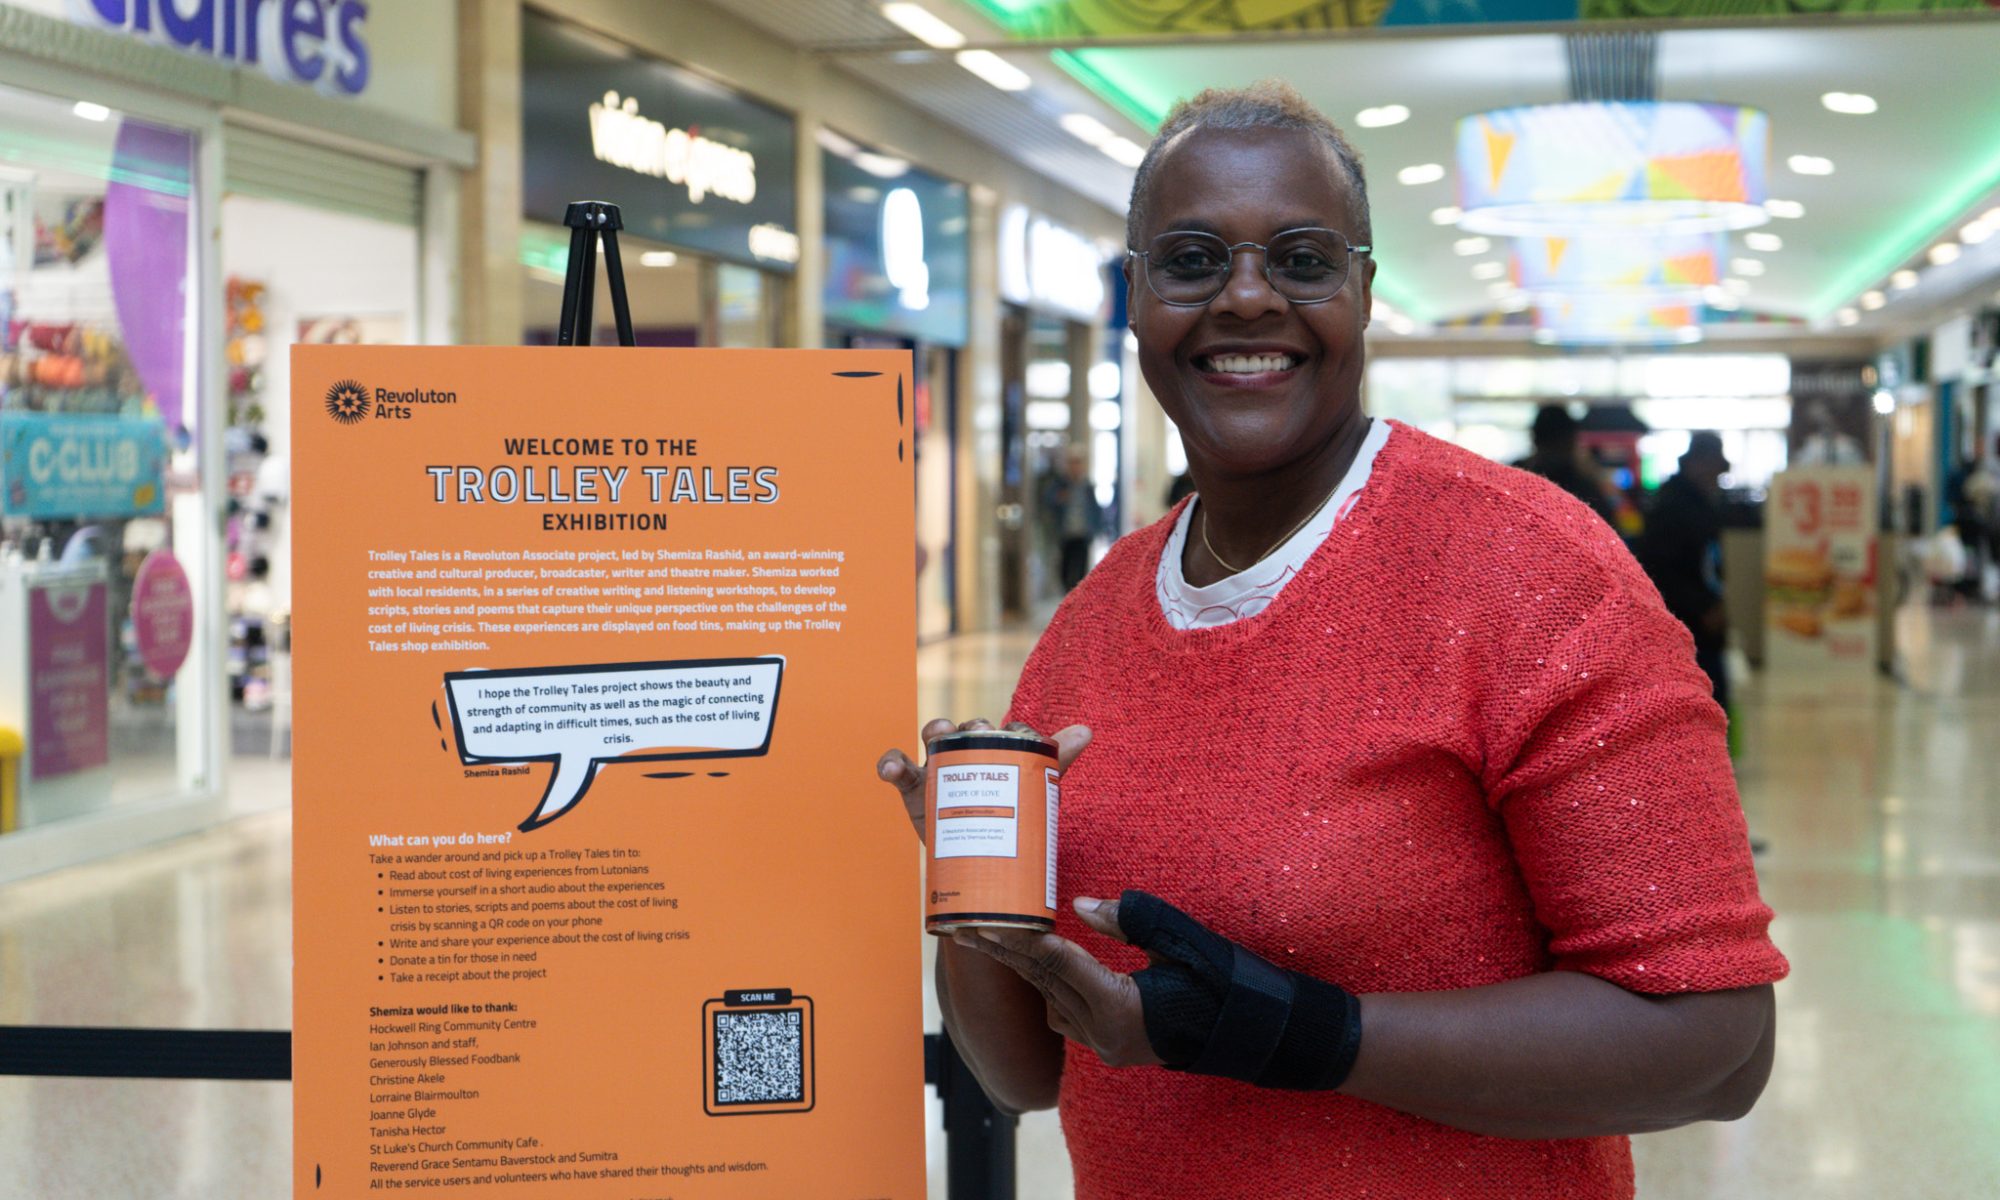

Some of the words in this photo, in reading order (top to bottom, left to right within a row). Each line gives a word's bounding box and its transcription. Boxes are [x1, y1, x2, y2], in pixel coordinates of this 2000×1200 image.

[375, 388, 457, 404] Revoluton
[375, 405, 412, 419] Arts
[504, 438, 614, 456] WELCOME
[621, 438, 649, 456] TO
[655, 438, 697, 456] THE
[426, 466, 629, 504] TROLLEY
[642, 466, 780, 504] TALES
[543, 513, 667, 531] EXHIBITION
[368, 550, 408, 563] Trolley
[409, 550, 439, 561] Tales
[441, 550, 452, 561] is
[454, 552, 461, 561] a
[463, 550, 520, 561] Revoluton
[522, 549, 576, 561] Associate
[578, 550, 619, 563] project,
[622, 550, 639, 560] led
[641, 550, 655, 562] by
[657, 549, 703, 560] Shemiza
[705, 549, 745, 561] Rashid,
[747, 551, 761, 560] an
[763, 549, 845, 563] award-winning
[368, 568, 414, 579] creative
[415, 568, 437, 579] and
[439, 568, 483, 579] cultural
[485, 568, 538, 580] producer,
[540, 568, 609, 579] broadcaster,
[611, 568, 645, 578] writer
[647, 567, 668, 578] and
[670, 568, 710, 578] theatre
[712, 567, 749, 577] maker.
[752, 566, 798, 577] Shemiza
[799, 566, 840, 577] worked
[368, 640, 399, 652] Tales
[401, 640, 429, 653] shop
[431, 640, 490, 651] exhibition.
[478, 689, 482, 699] I
[484, 689, 511, 700] hope
[513, 687, 531, 697] the
[533, 685, 569, 697] Trolley
[571, 684, 599, 694] Tales
[601, 682, 638, 695] project
[640, 681, 673, 691] shows
[675, 679, 693, 689] the
[695, 678, 730, 689] beauty
[732, 675, 752, 686] and
[467, 705, 512, 718] strength
[515, 704, 526, 714] of
[528, 702, 587, 714] community
[589, 702, 602, 711] as
[603, 699, 626, 710] well
[628, 700, 640, 709] as
[642, 698, 660, 708] the
[662, 696, 693, 709] magic
[695, 694, 706, 705] of
[708, 692, 764, 705] connecting
[473, 723, 493, 734] and
[495, 721, 542, 734] adapting
[544, 720, 554, 730] in
[556, 718, 598, 730] difficult
[599, 717, 632, 727] times,
[634, 715, 659, 726] such
[661, 715, 673, 724] as
[675, 713, 693, 723] the
[695, 712, 717, 722] cost
[718, 710, 730, 721] of
[731, 710, 760, 722] living
[603, 733, 634, 744] crisis.
[463, 769, 500, 778] Shemiza
[501, 767, 530, 776] Rashid
[943, 772, 977, 782] TROLLEY
[979, 772, 1009, 781] TALES
[369, 834, 404, 847] What
[407, 836, 429, 846] can
[432, 835, 456, 848] you
[458, 832, 474, 845] do
[477, 831, 512, 844] here?
[389, 870, 415, 881] Read
[418, 870, 447, 880] about
[449, 870, 470, 879] cost
[473, 867, 483, 878] of
[485, 868, 512, 881] living
[514, 868, 573, 879] experiences
[575, 865, 599, 876] from
[601, 865, 650, 875] Lutonians
[389, 888, 434, 897] Immerse
[436, 884, 478, 898] yourself
[480, 886, 489, 895] in
[491, 886, 497, 895] a
[499, 884, 526, 895] short
[528, 883, 556, 894] audio
[558, 883, 586, 893] about
[588, 882, 605, 892] the
[607, 882, 665, 894] experiences
[390, 972, 415, 983] Take
[416, 974, 423, 982] a
[425, 971, 460, 983] receipt
[461, 970, 491, 981] about
[493, 969, 510, 980] the
[512, 968, 547, 981] project
[741, 993, 762, 1002] SCAN
[763, 993, 775, 1001] ME
[369, 1006, 414, 1017] Shemiza
[416, 1004, 449, 1015] would
[451, 1004, 470, 1014] like
[471, 1004, 483, 1013] to
[484, 1002, 517, 1013] thank:
[369, 1023, 416, 1034] Hockwell
[419, 1022, 442, 1035] Ring
[443, 1020, 502, 1032] Community
[503, 1019, 537, 1030] Centre
[369, 1041, 385, 1052] Ian
[388, 1040, 429, 1051] Johnson
[431, 1038, 450, 1049] and
[453, 1036, 478, 1049] staff,
[369, 1056, 427, 1069] Generously
[429, 1055, 469, 1066] Blessed
[471, 1053, 521, 1065] Foodbank
[369, 1074, 415, 1086] Christine
[418, 1073, 445, 1083] Akele
[370, 1093, 412, 1103] Lorraine
[414, 1089, 480, 1101] Blairmoulton
[369, 1110, 405, 1121] Joanne
[407, 1107, 436, 1121] Glyde
[369, 1126, 410, 1138] Tanisha
[412, 1125, 446, 1135] Hector
[370, 1160, 419, 1172] Reverend
[421, 1159, 450, 1170] Grace
[452, 1158, 498, 1168] Sentamu
[500, 1153, 556, 1166] Baverstock
[558, 1152, 577, 1164] and
[578, 1151, 619, 1162] Sumitra
[369, 1178, 383, 1190] All
[385, 1178, 403, 1189] the
[404, 1178, 441, 1188] service
[442, 1176, 471, 1186] users
[472, 1174, 492, 1185] and
[494, 1173, 548, 1184] volunteers
[549, 1171, 572, 1181] who
[573, 1169, 598, 1180] have
[599, 1167, 634, 1179] shared
[635, 1166, 659, 1177] their
[661, 1164, 705, 1177] thoughts
[707, 1162, 726, 1174] and
[727, 1161, 768, 1172] wisdom.
